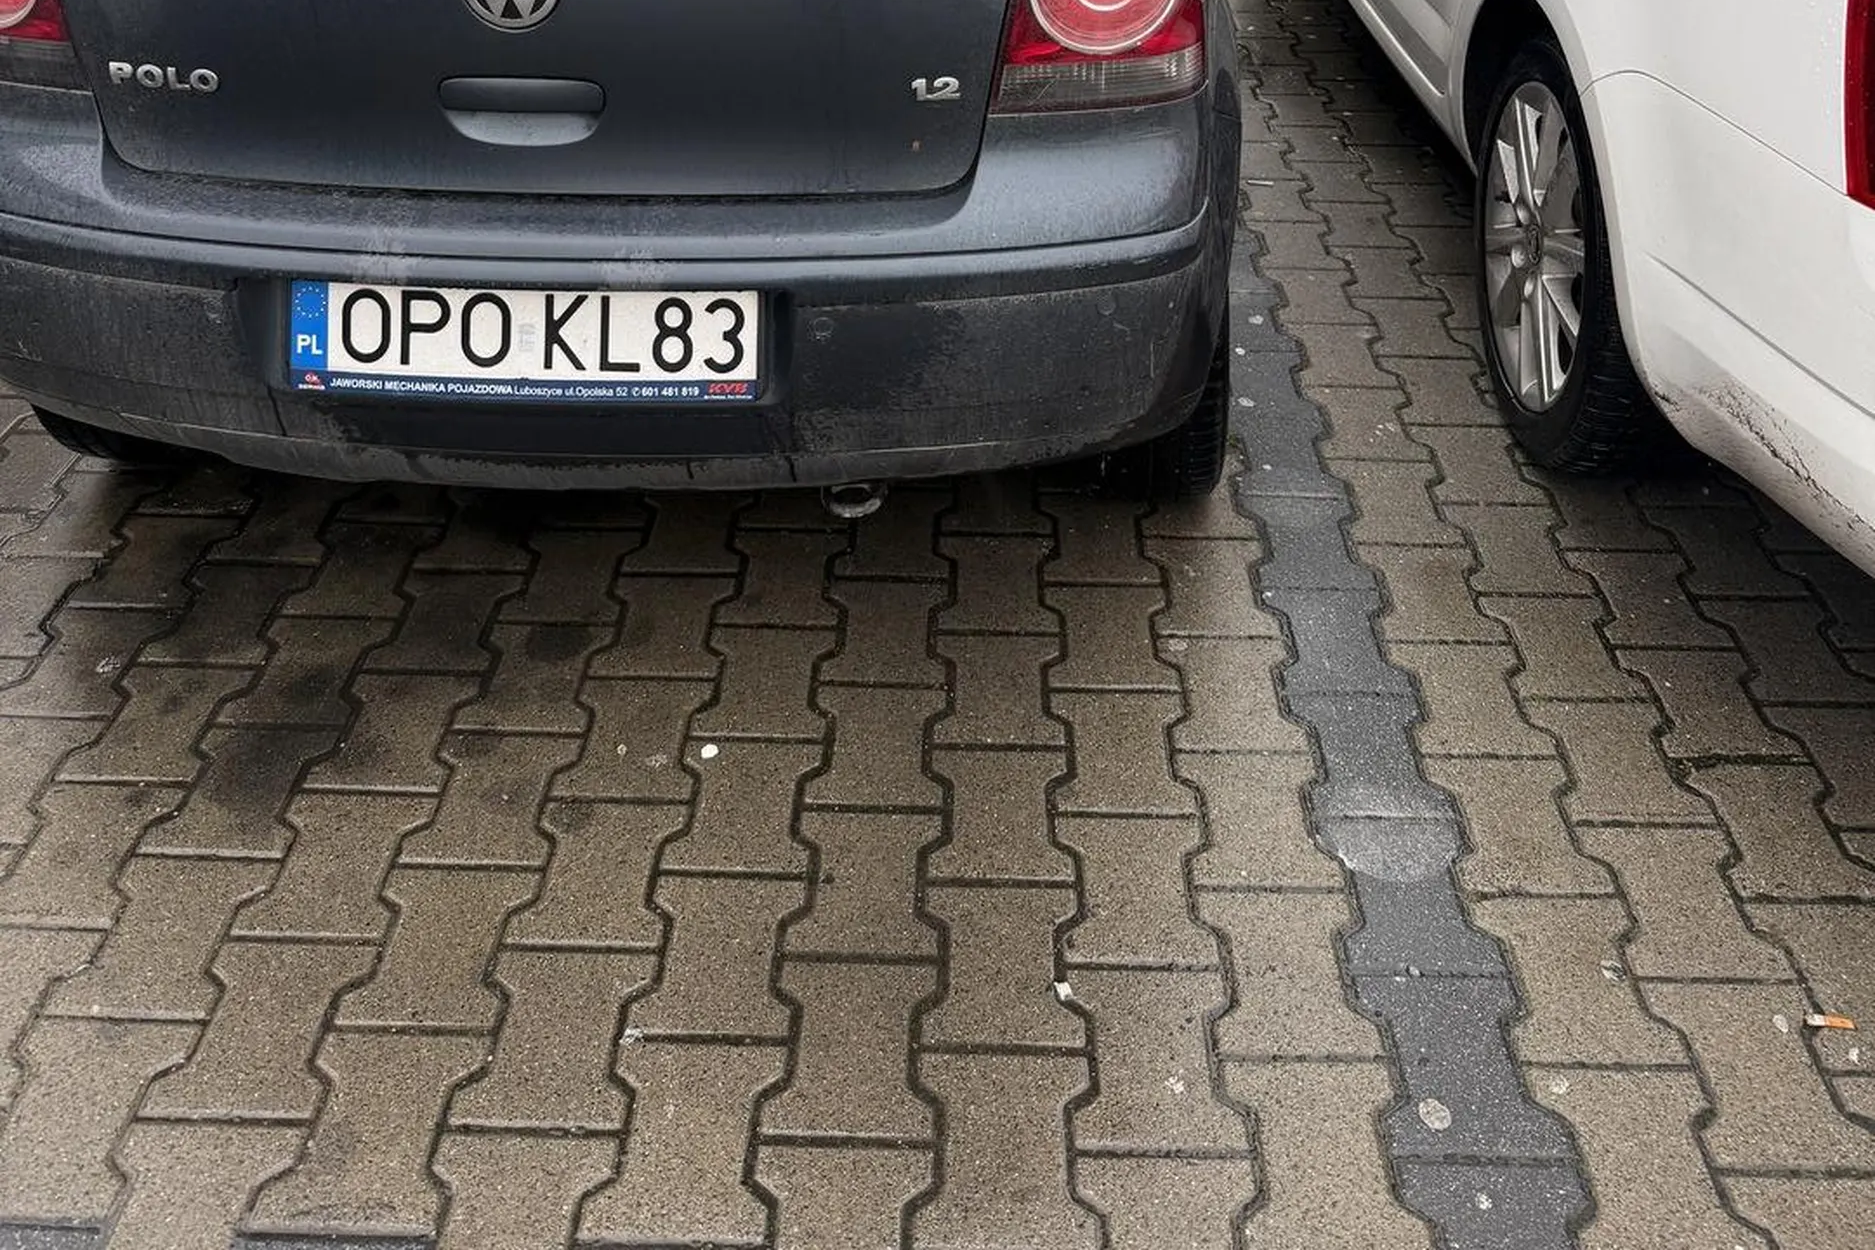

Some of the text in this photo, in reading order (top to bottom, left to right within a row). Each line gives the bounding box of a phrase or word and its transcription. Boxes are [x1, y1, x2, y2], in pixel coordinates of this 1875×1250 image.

[108, 61, 219, 94] POLO
[297, 334, 323, 355] PL
[342, 288, 746, 374] OPO KL83
[330, 378, 383, 390] JAWORSKI
[384, 380, 446, 393] MECHANIKA
[447, 382, 513, 395] POJAZDOWA
